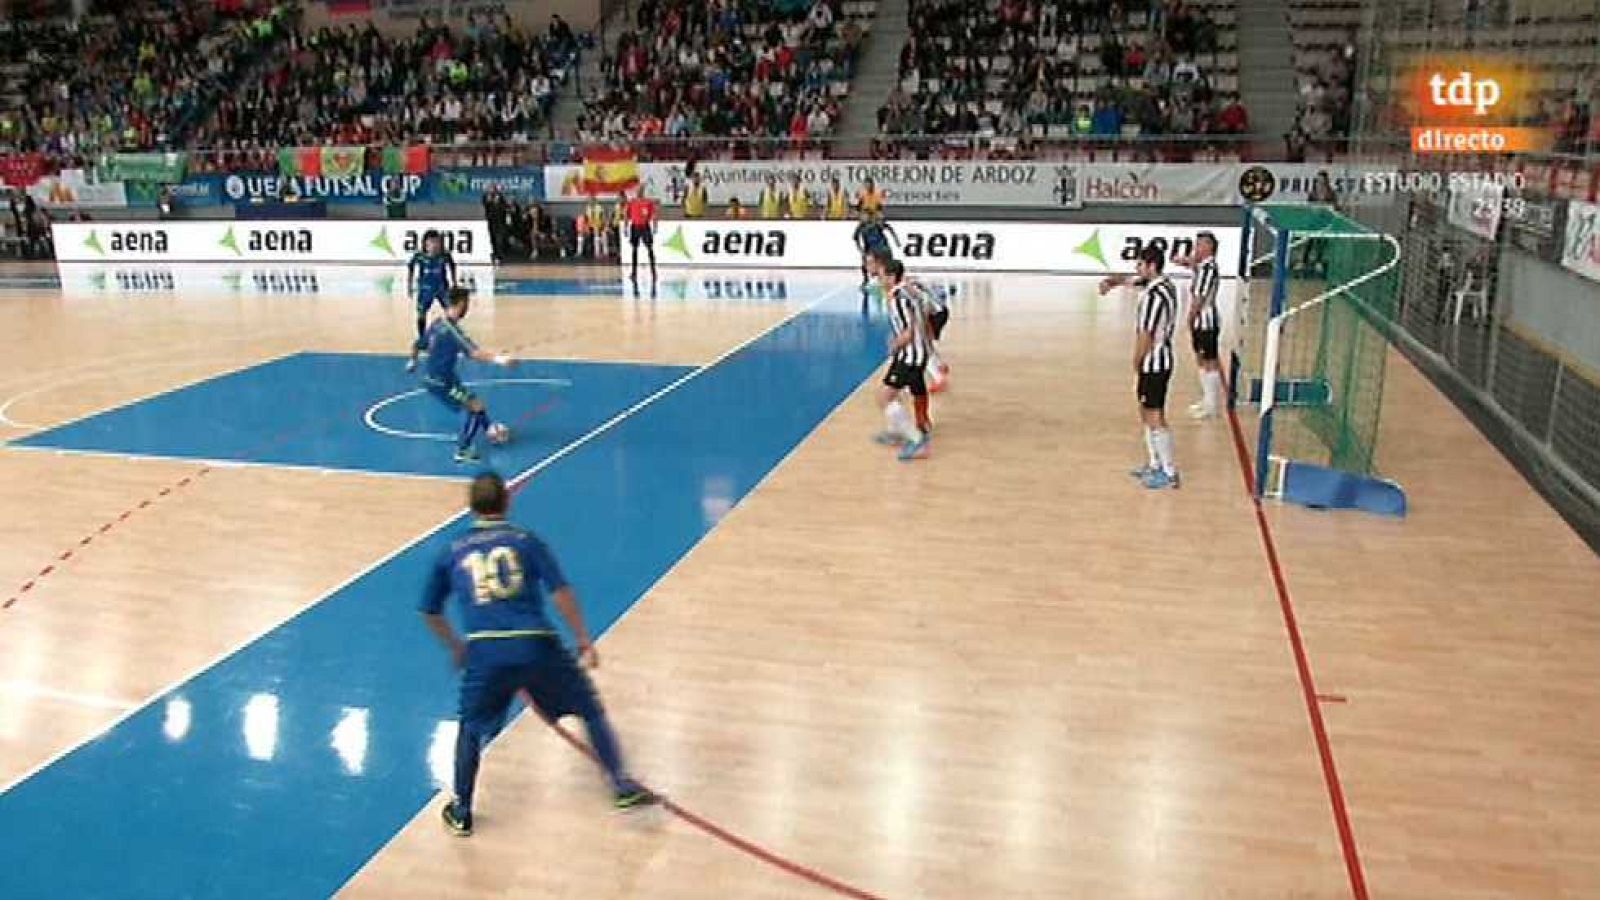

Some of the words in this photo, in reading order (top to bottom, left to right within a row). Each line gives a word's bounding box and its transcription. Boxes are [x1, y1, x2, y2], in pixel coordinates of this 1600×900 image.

[304, 174, 378, 197] FUTSAL
[381, 174, 422, 197] CUP
[820, 164, 842, 183] de
[940, 165, 965, 183] DE
[972, 165, 1036, 184] ARDOZ
[110, 229, 168, 253] aena
[248, 227, 313, 253] aena
[403, 228, 474, 254] ana
[701, 228, 787, 258] aena
[903, 231, 996, 260] aena
[461, 546, 524, 605] 10
